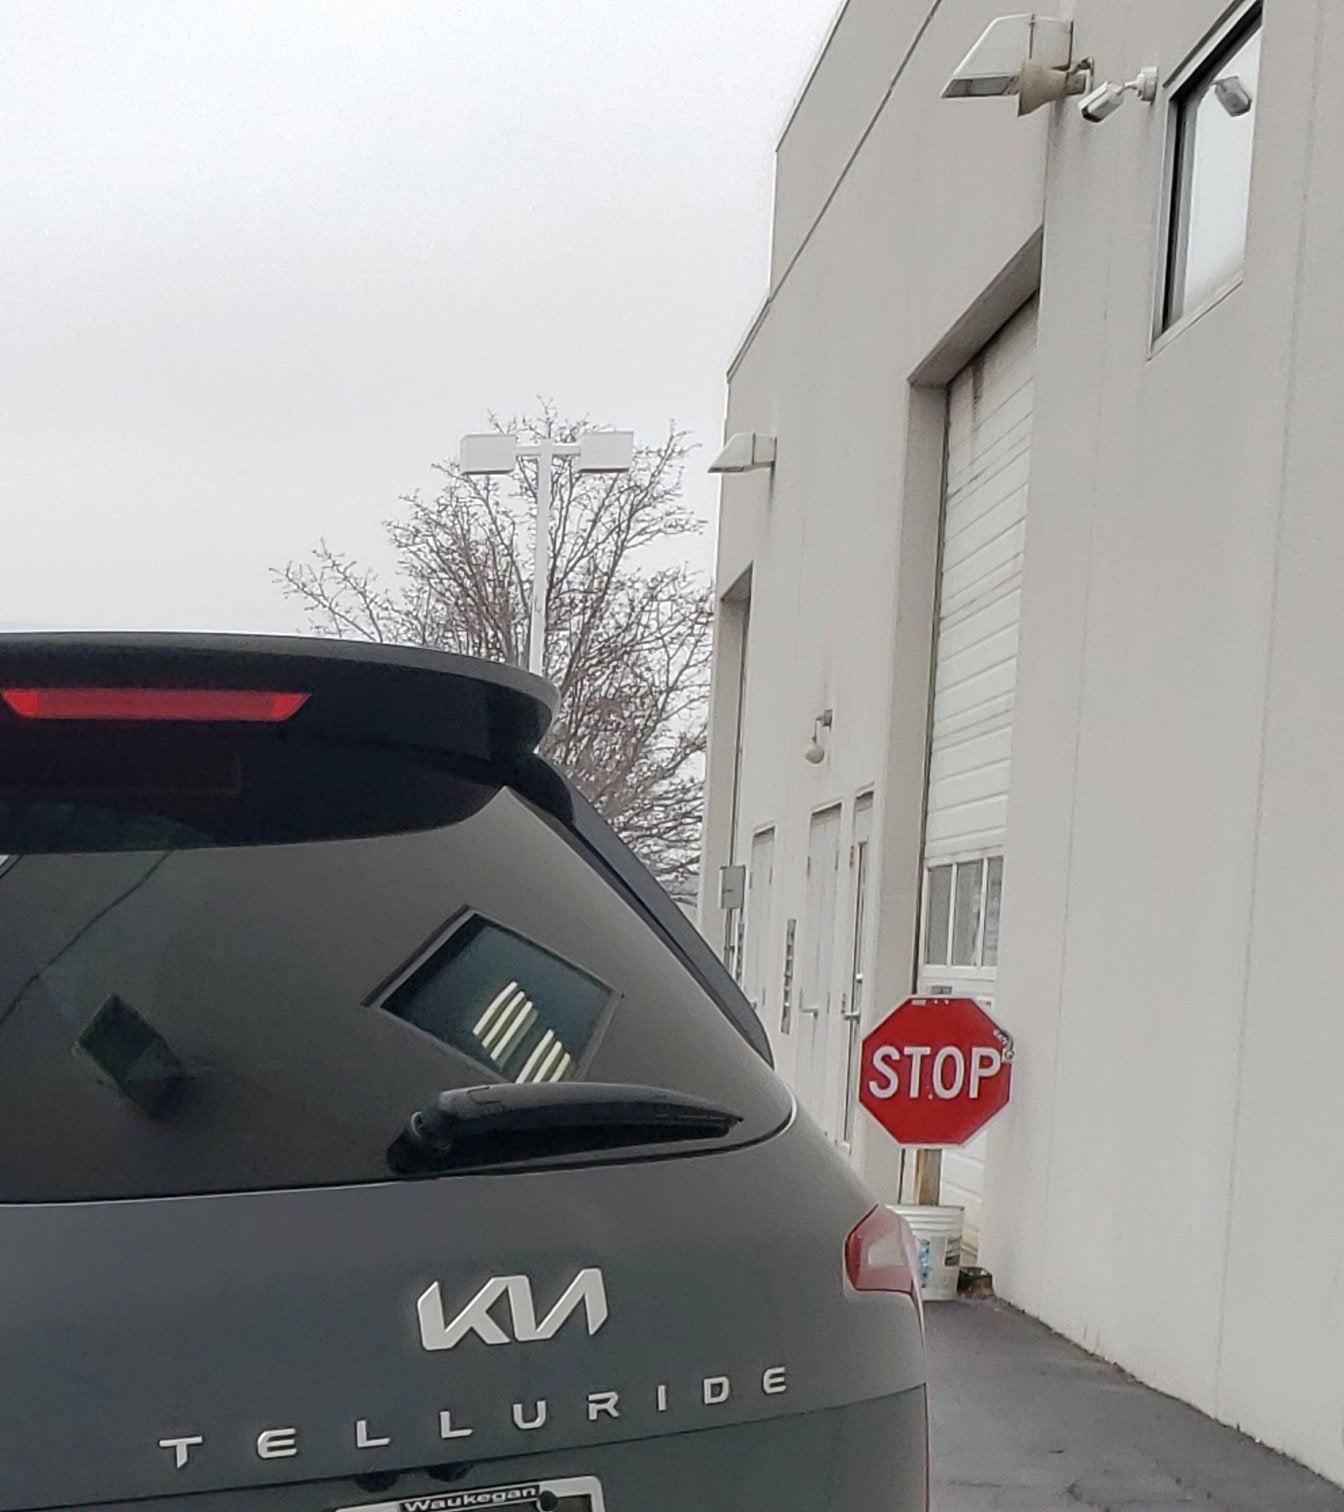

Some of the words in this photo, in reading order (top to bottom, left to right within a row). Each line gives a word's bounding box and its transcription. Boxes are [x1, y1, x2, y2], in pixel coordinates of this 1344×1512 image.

[869, 1046, 1001, 1099] STOP
[417, 1268, 608, 1350] KIA
[159, 1367, 787, 1467] TELLURIDE
[404, 1486, 537, 1512] Waukegan
